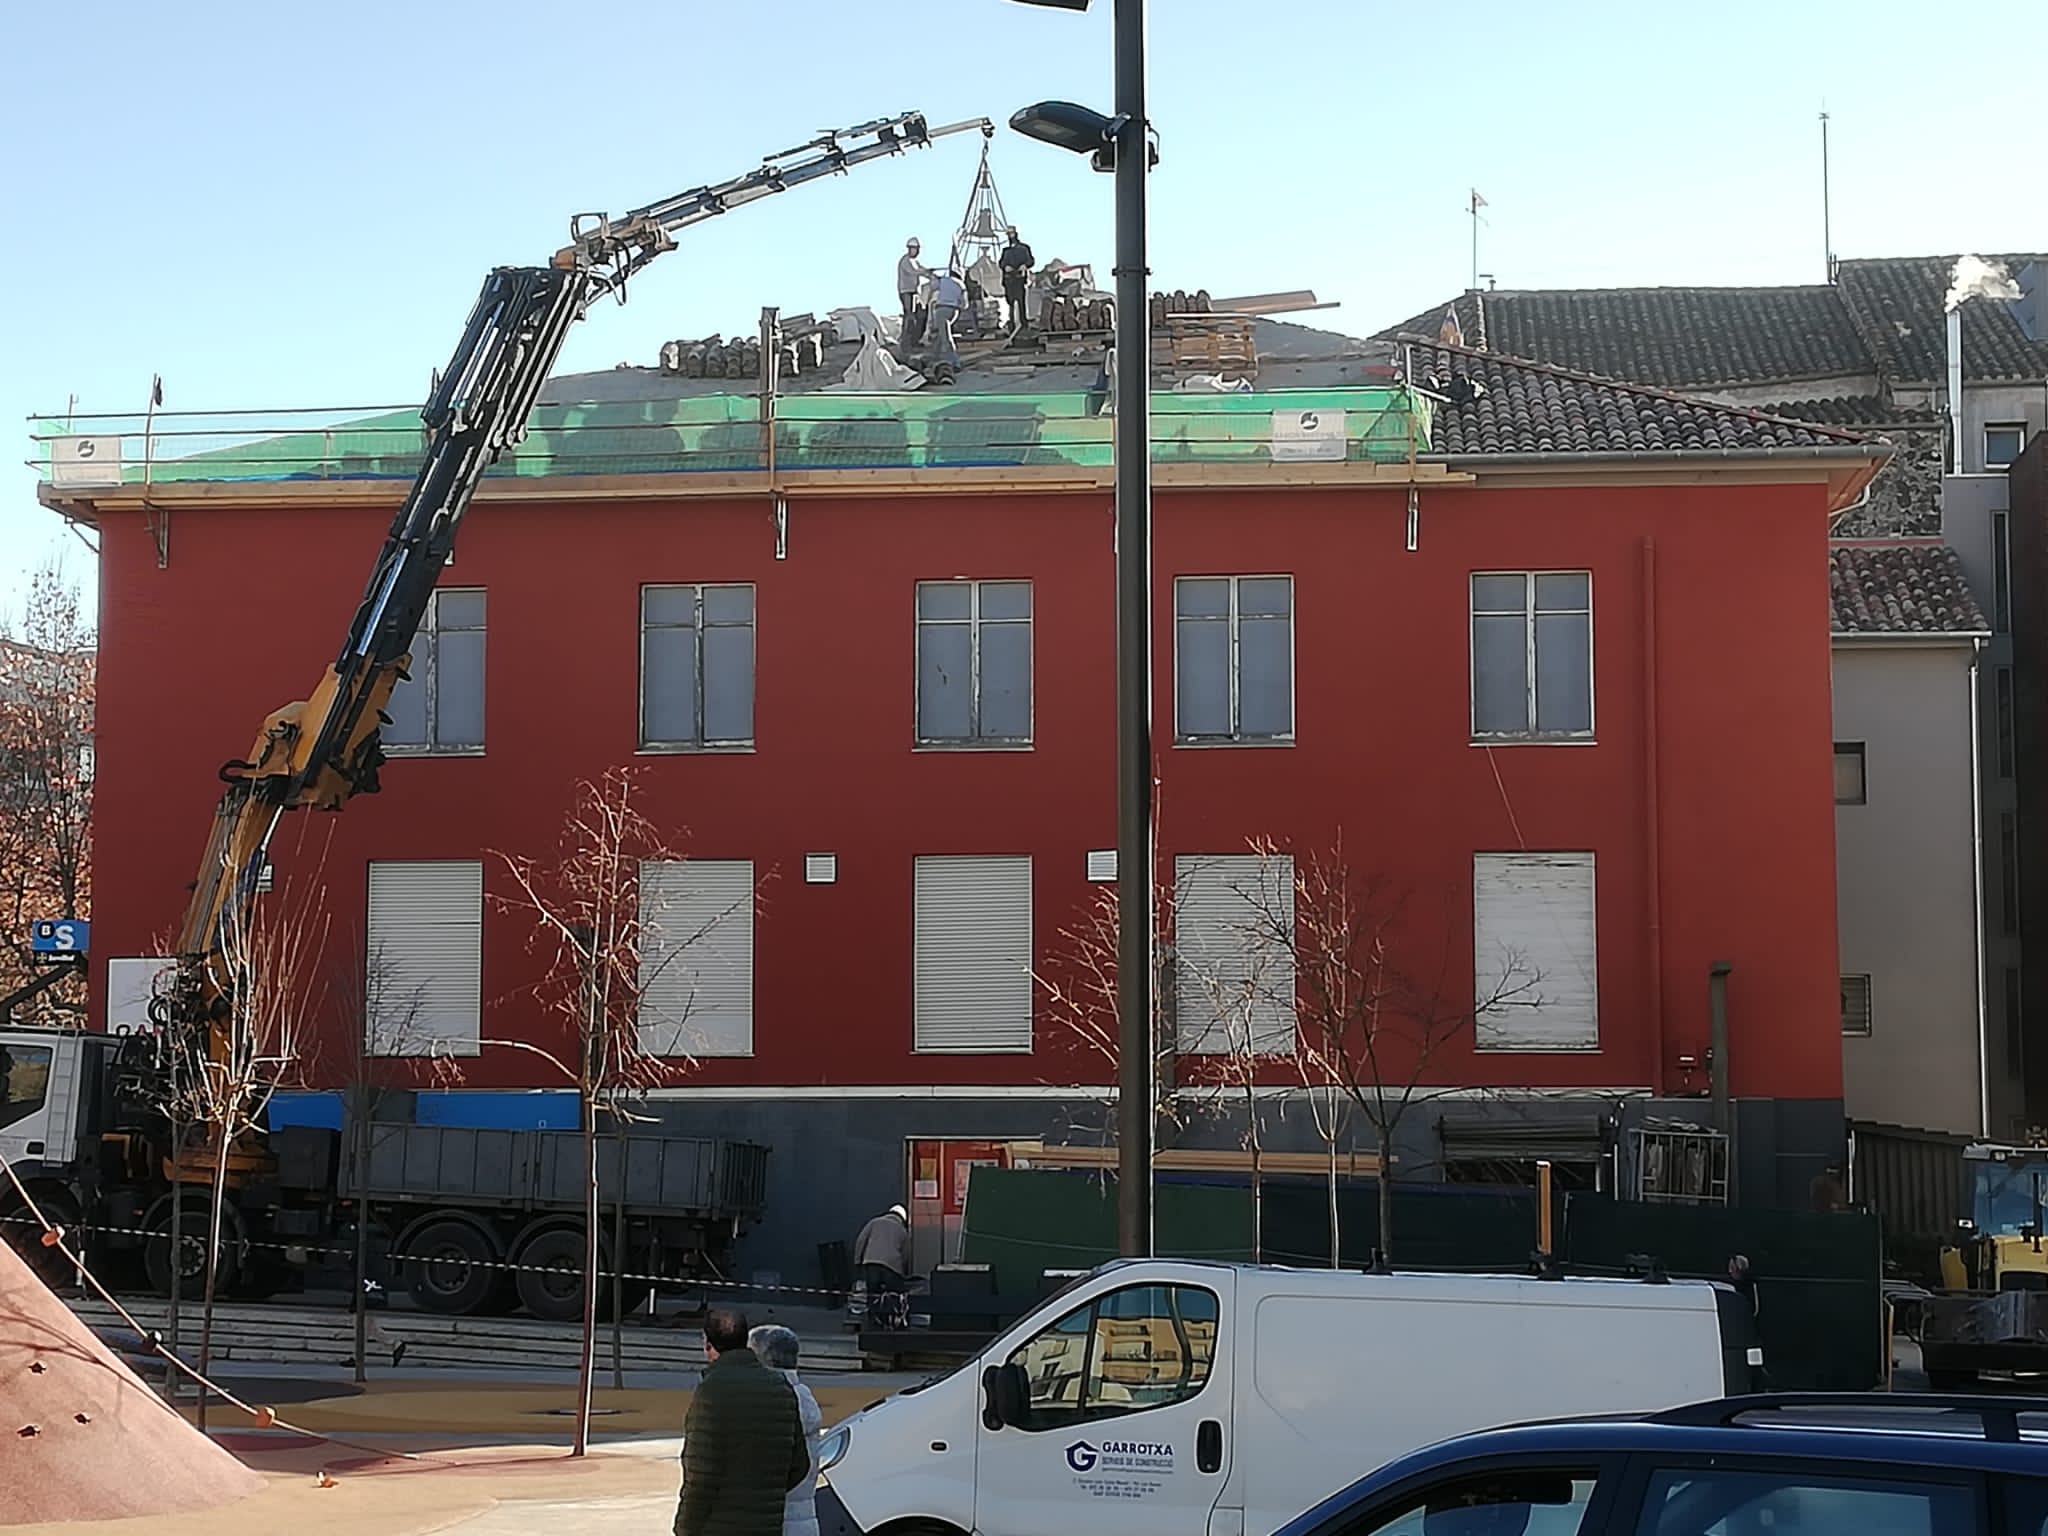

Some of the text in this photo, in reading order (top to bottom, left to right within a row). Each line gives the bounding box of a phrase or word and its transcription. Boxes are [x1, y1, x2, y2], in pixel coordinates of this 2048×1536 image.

[41, 925, 74, 950] B S
[1102, 1441, 1173, 1456] GARROTXA
